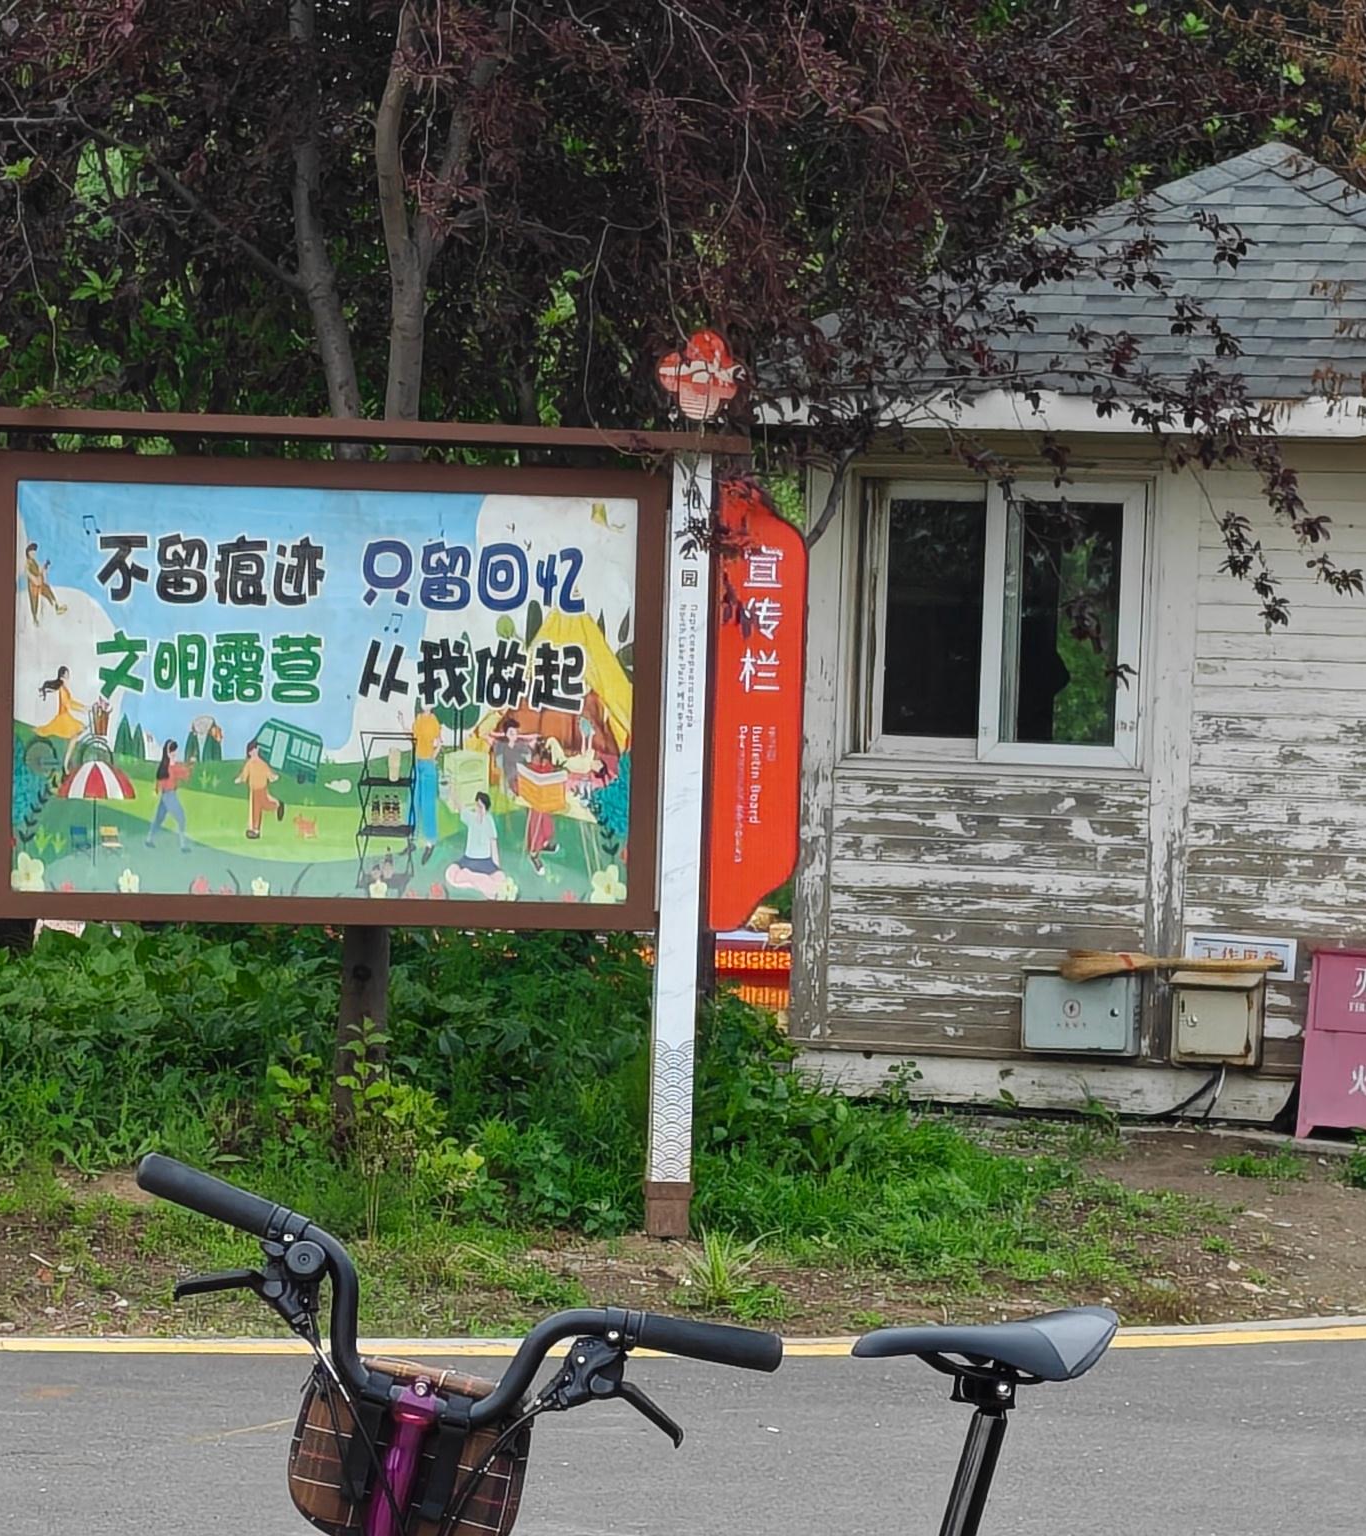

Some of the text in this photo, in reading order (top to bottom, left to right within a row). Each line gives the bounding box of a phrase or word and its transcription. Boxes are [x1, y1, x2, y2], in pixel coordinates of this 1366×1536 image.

[98, 535, 585, 612] 不留痕迹 只留回忆
[739, 544, 784, 692] 宣传栏
[96, 630, 585, 711] 文明露营 从我做起
[749, 726, 763, 824] Bulletin Board
